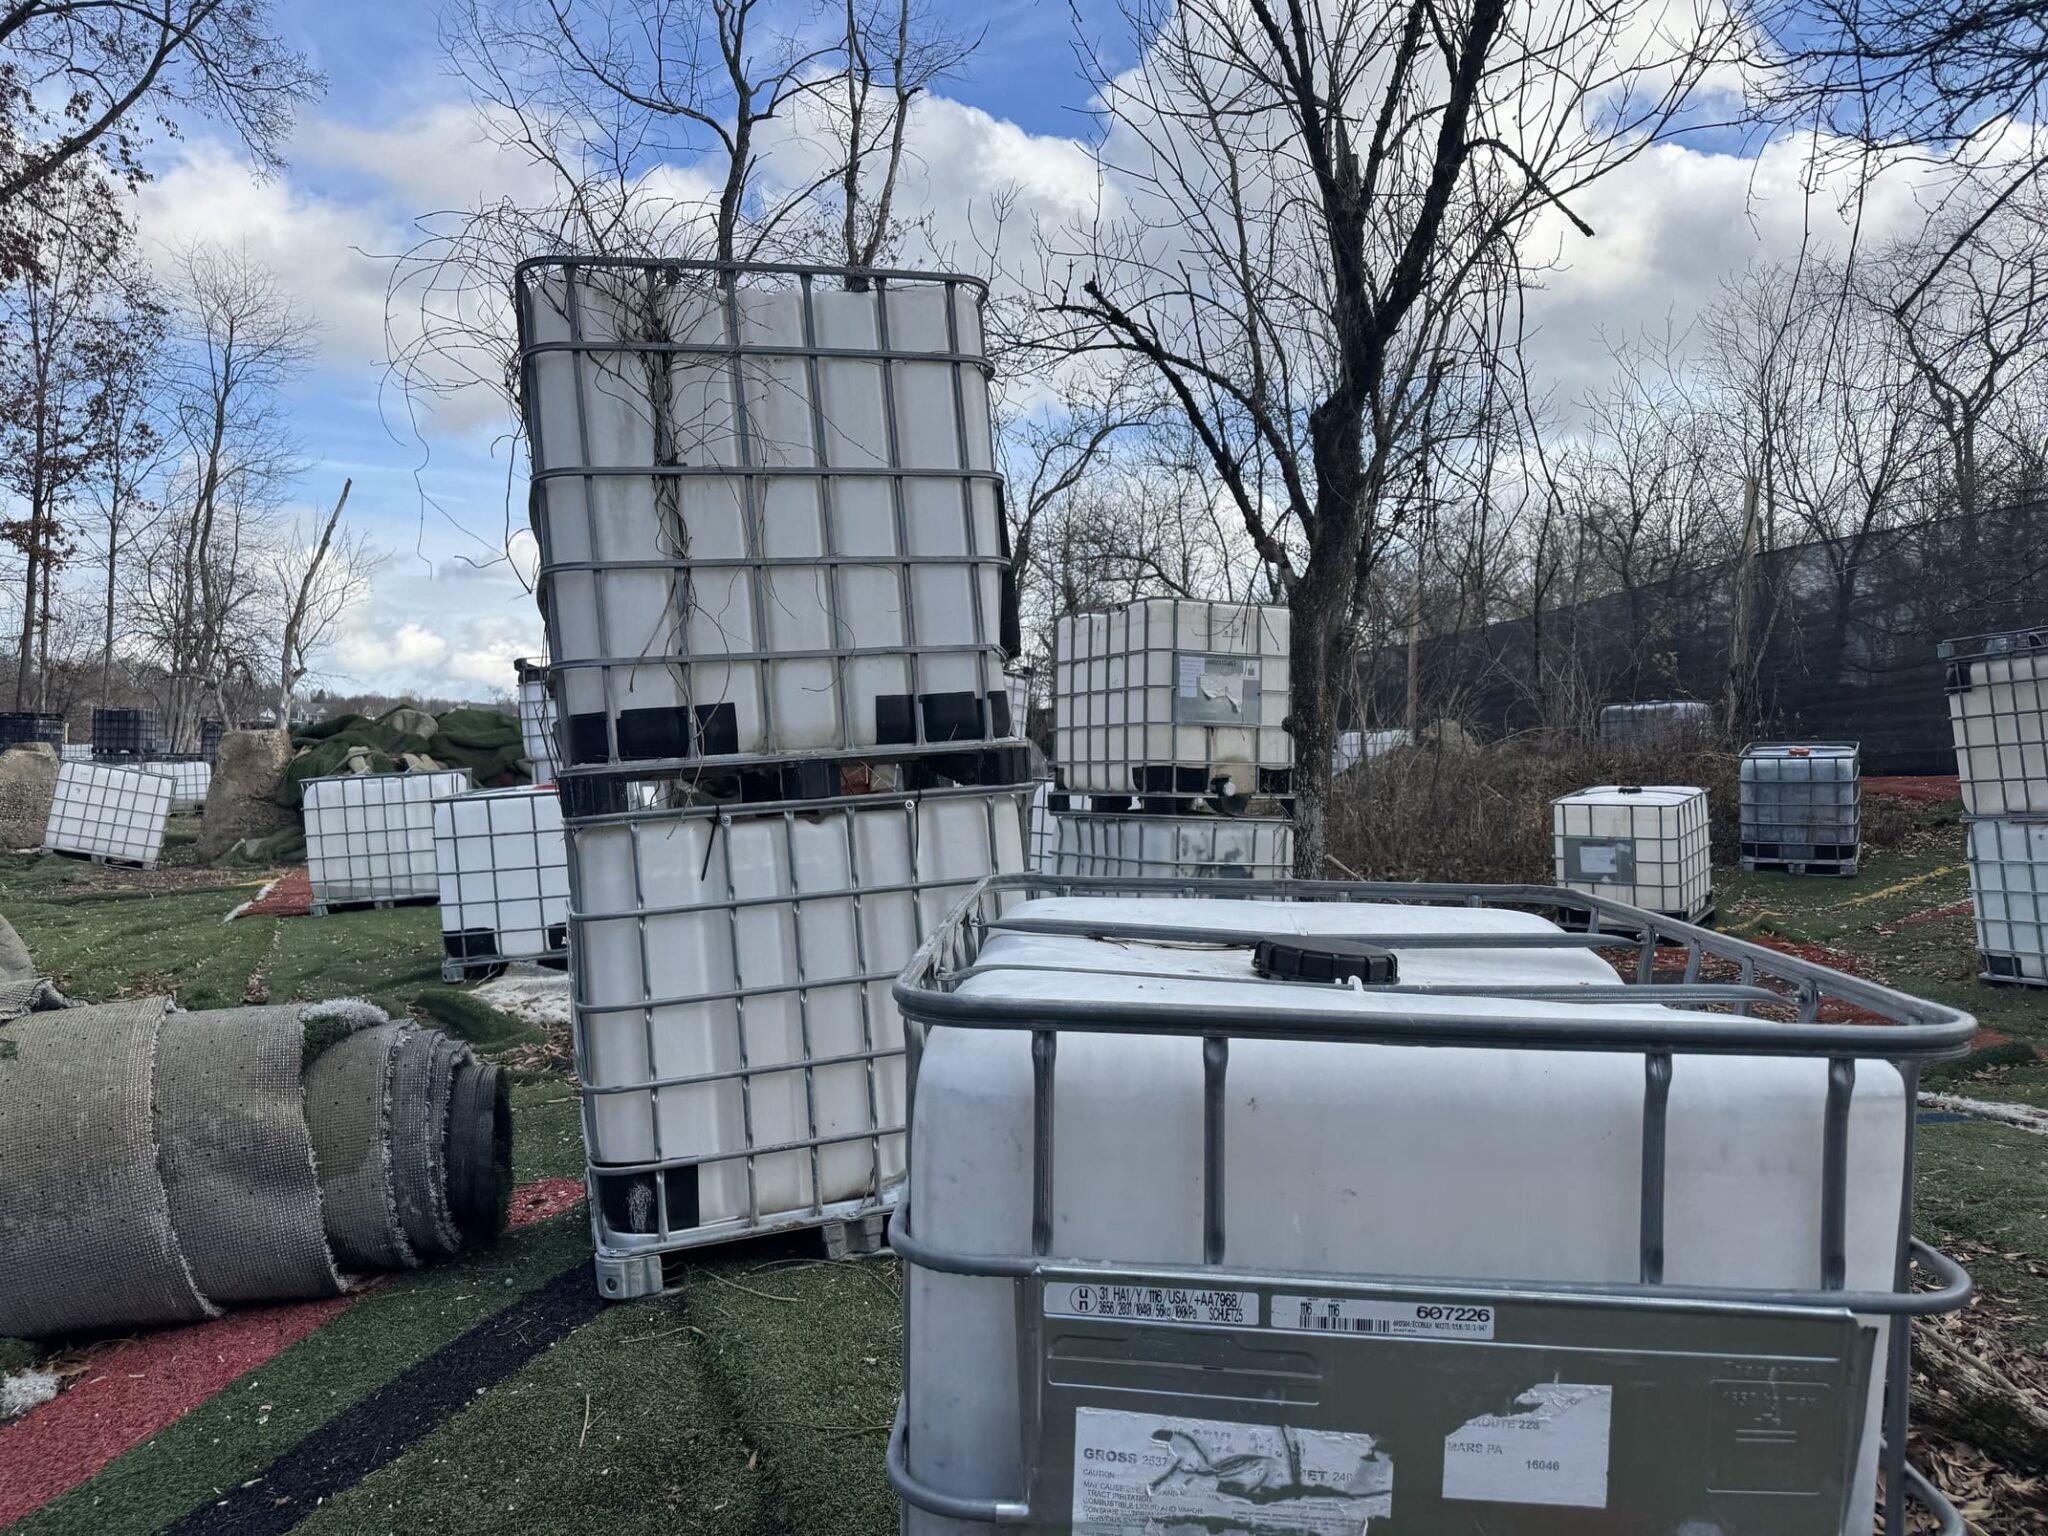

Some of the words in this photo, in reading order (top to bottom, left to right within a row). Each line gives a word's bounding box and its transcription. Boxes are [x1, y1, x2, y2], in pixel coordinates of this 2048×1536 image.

[1099, 1286, 1109, 1300] 31
[1416, 1305, 1490, 1322] 607226
[1518, 1420, 1540, 1430] 228
[1447, 1442, 1483, 1453] MARS
[1486, 1444, 1503, 1455] PA
[1083, 1447, 1138, 1463] GROSS
[1142, 1455, 1169, 1467] 2537
[1526, 1460, 1560, 1471] 16046
[1301, 1469, 1328, 1481] ET
[1083, 1481, 1098, 1489] MAY
[1100, 1482, 1125, 1491] CAUSE
[1087, 1489, 1111, 1498] TRACT
[1082, 1497, 1134, 1509] COMBUSTIBLE
